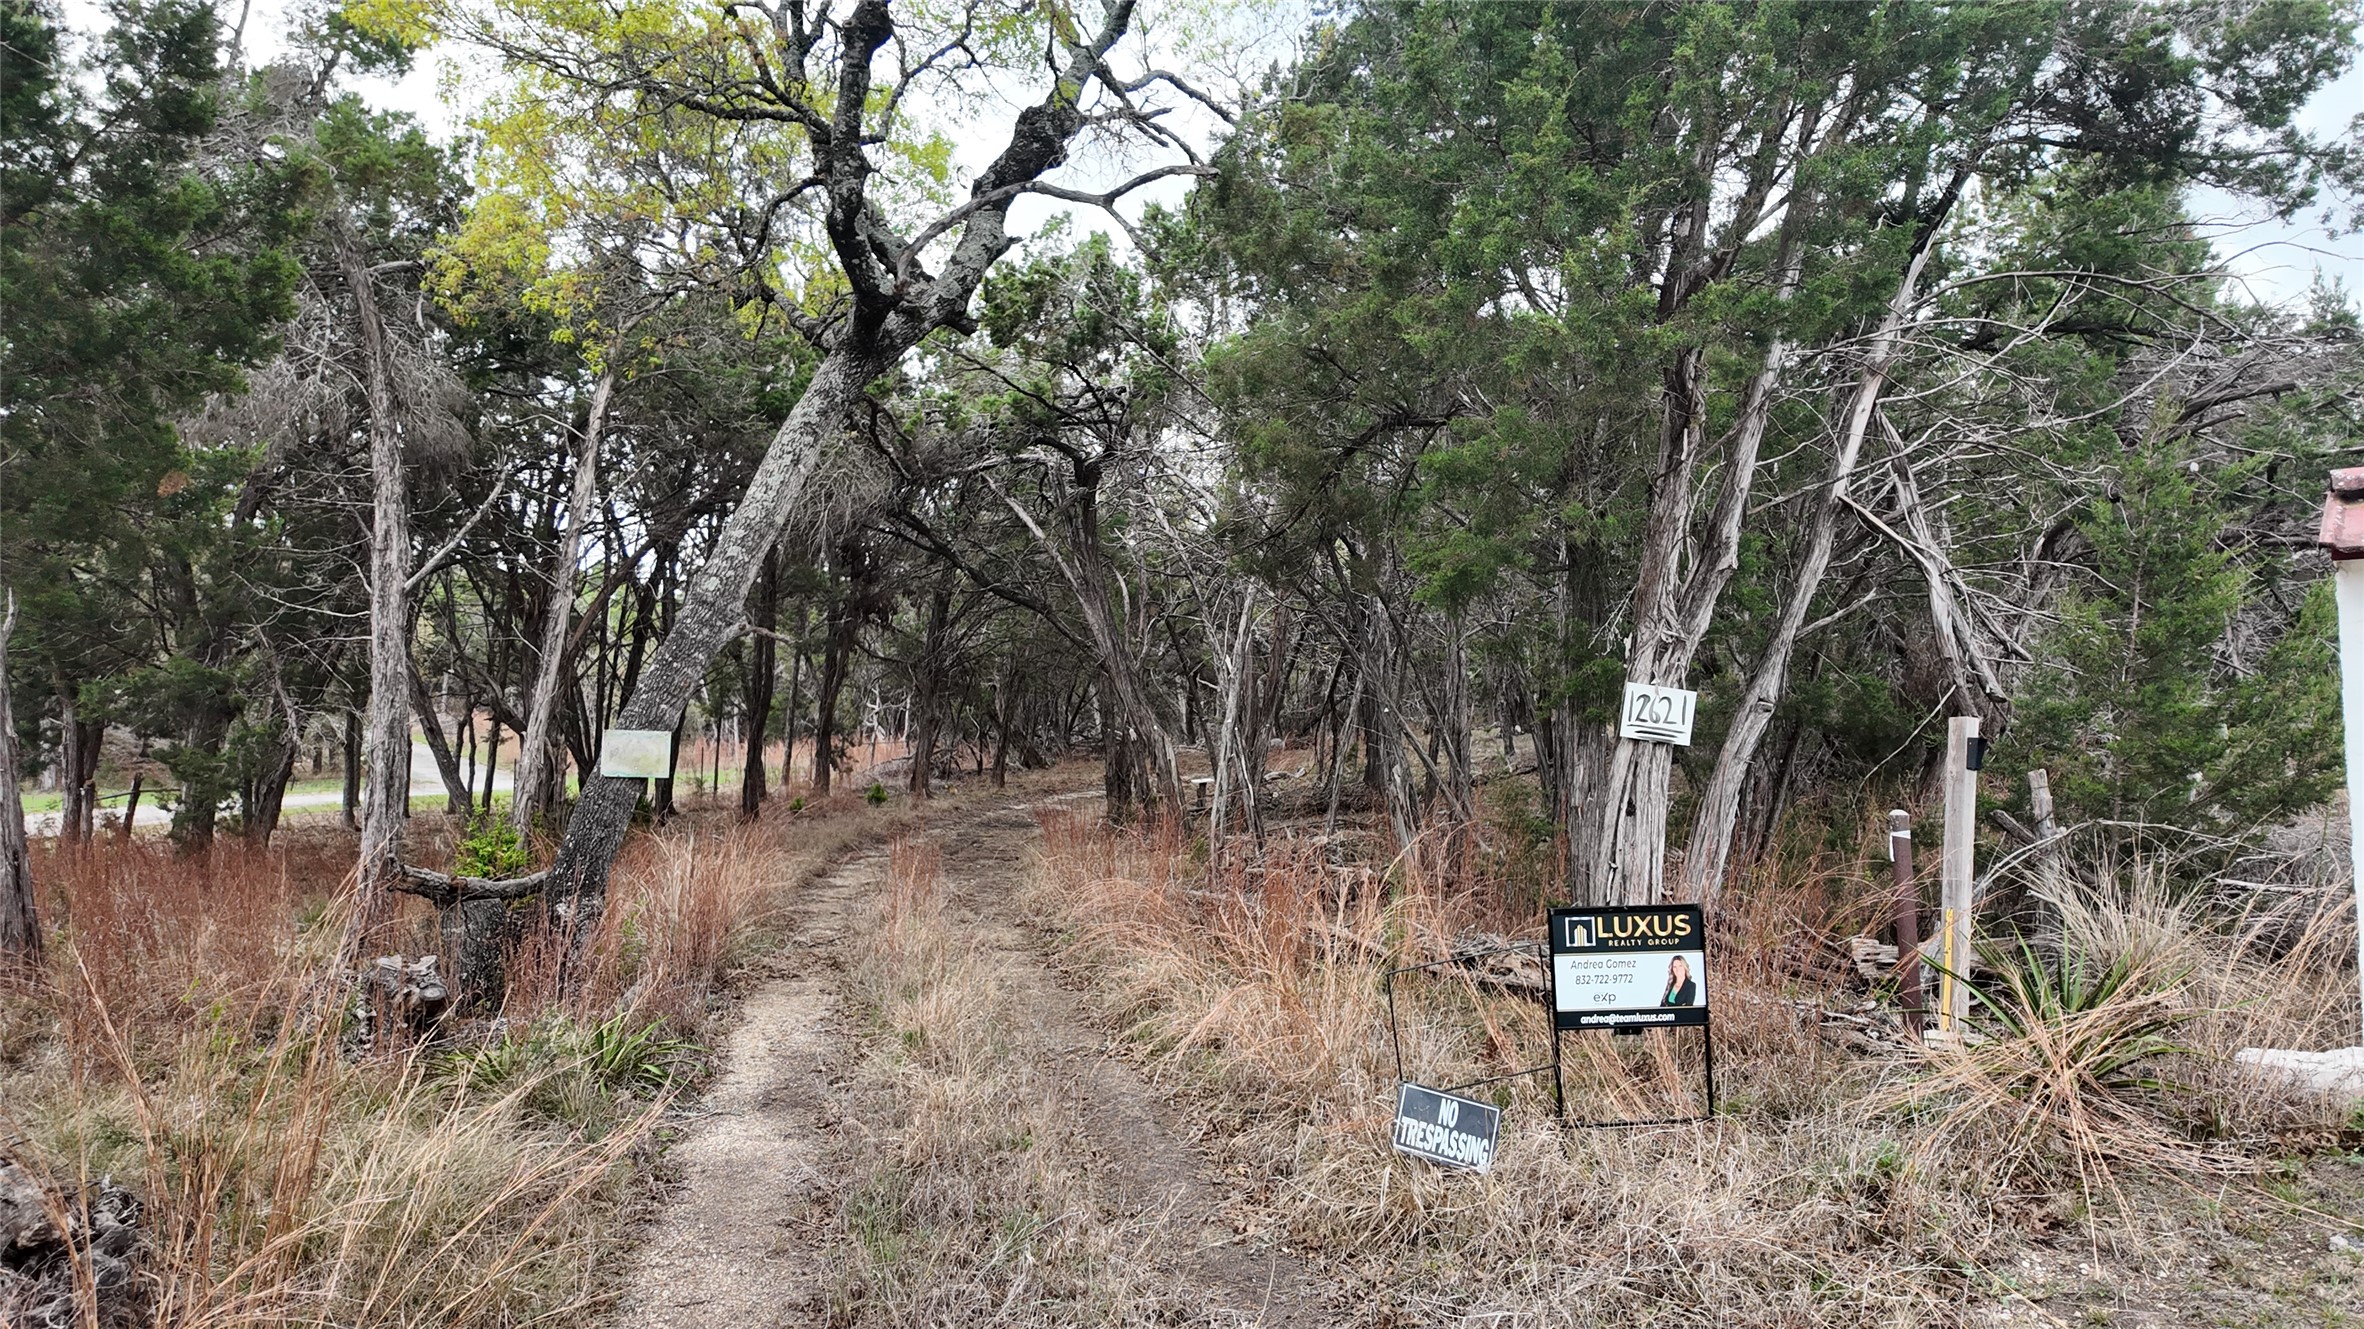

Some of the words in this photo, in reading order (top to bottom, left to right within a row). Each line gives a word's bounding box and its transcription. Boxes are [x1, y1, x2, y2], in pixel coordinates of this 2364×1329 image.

[1628, 690, 1687, 726] 12621
[1597, 914, 1692, 938] LUXUS
[1608, 939, 1642, 947] REALTY
[1647, 938, 1680, 946] GROUP
[1570, 959, 1603, 970] Andrea
[1605, 958, 1637, 969] Gomez
[1575, 974, 1634, 985] 832-722-9772
[1580, 1012, 1675, 1025] andrea@teamluxus.com
[1437, 1098, 1460, 1128] NO
[1400, 1115, 1490, 1166] TRESPASSING
